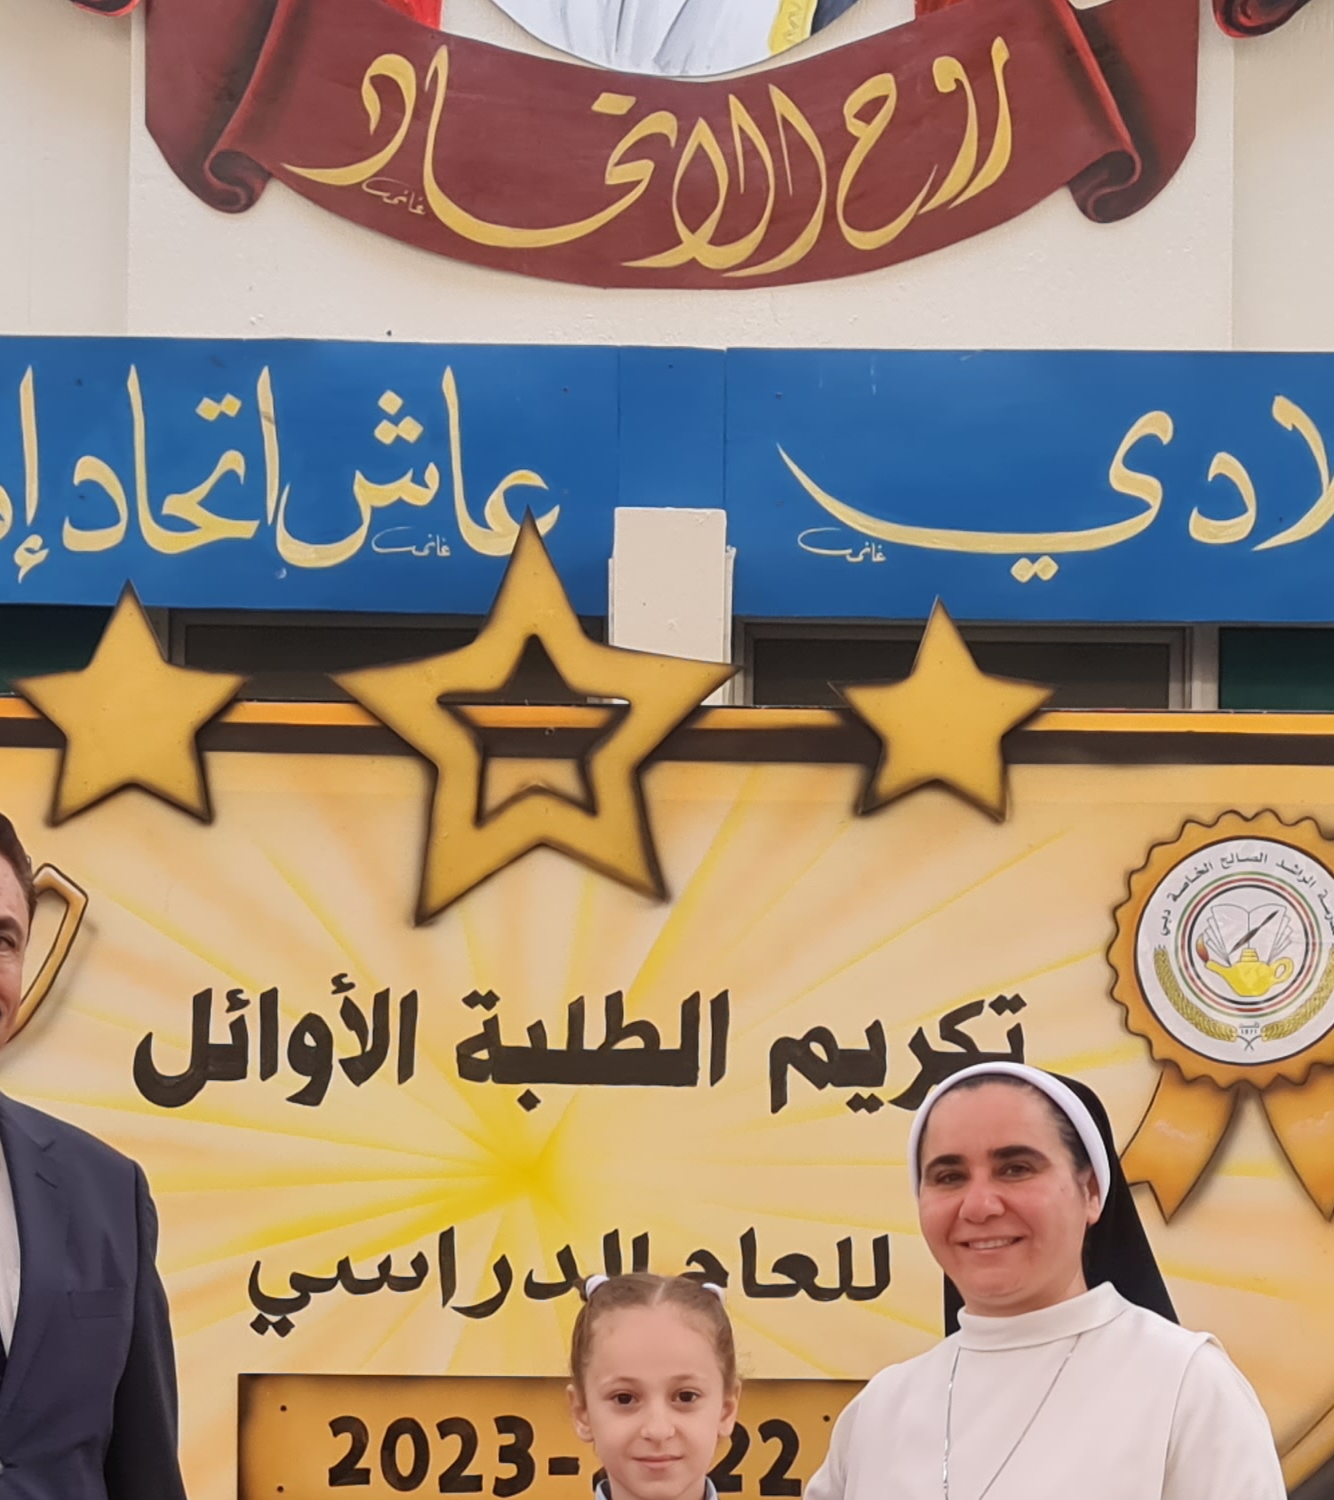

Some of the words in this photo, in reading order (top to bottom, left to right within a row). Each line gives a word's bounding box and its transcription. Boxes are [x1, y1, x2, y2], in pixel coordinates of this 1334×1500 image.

[63, 362, 280, 557] اتحاد
[273, 364, 561, 568] عاش
[1219, 851, 1269, 871] الصالح
[131, 971, 420, 1108] الأوائل
[454, 987, 731, 1112] الطلبة
[768, 992, 1028, 1115] تكريم
[326, 1414, 803, 1499] 2023-22
